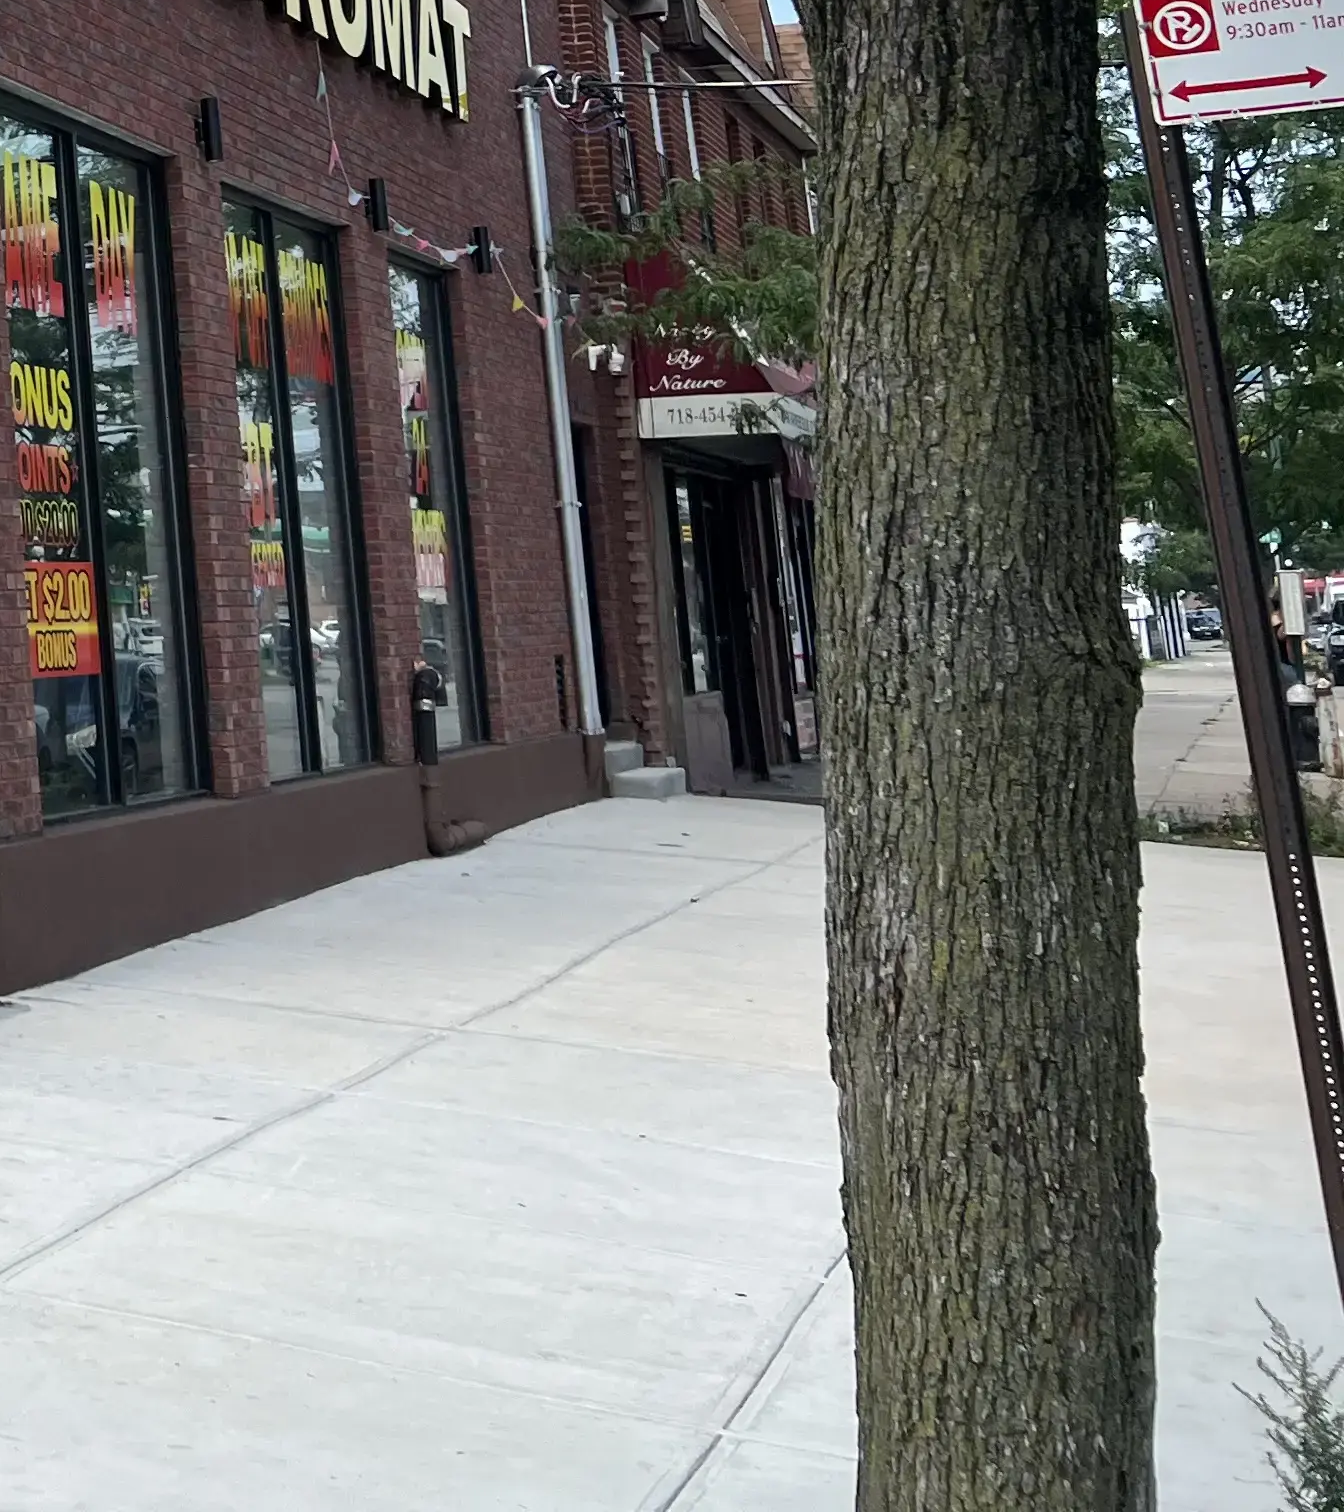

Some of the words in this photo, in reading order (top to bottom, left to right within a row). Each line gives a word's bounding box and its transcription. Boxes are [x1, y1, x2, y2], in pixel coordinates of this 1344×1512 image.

[1226, 20, 1295, 40] 9:30am
[3, 150, 65, 318] AME
[88, 179, 138, 338] DAY
[649, 374, 727, 392] Nature
[666, 348, 705, 371] By
[10, 360, 73, 433] ONUS
[16, 439, 71, 494] OINTS
[42, 567, 92, 625] $2.00
[35, 629, 78, 673] BONUS
